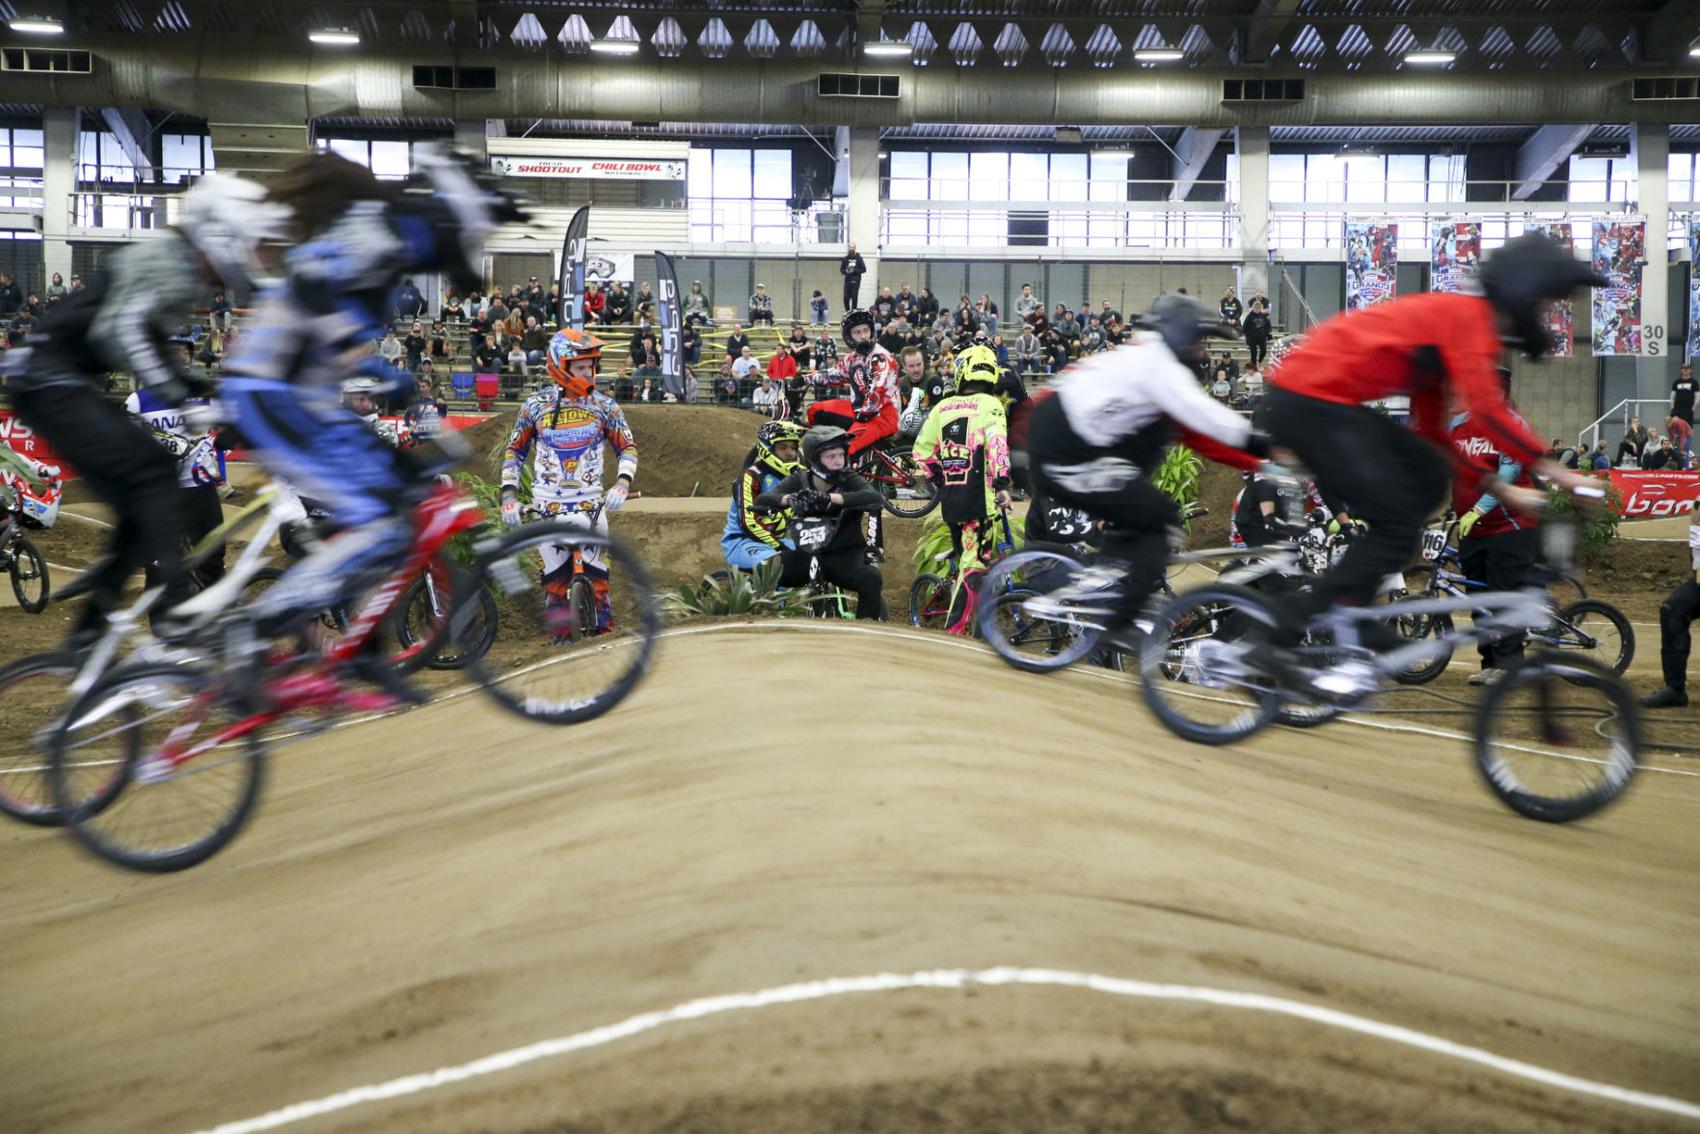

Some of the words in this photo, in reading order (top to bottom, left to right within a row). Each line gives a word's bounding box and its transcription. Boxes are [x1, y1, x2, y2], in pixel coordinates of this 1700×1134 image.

[517, 165, 583, 174] SHOOTOUT
[591, 162, 625, 171] CHILI
[626, 163, 663, 172] BOWL
[1643, 325, 1664, 339] 30
[1648, 341, 1660, 355] S
